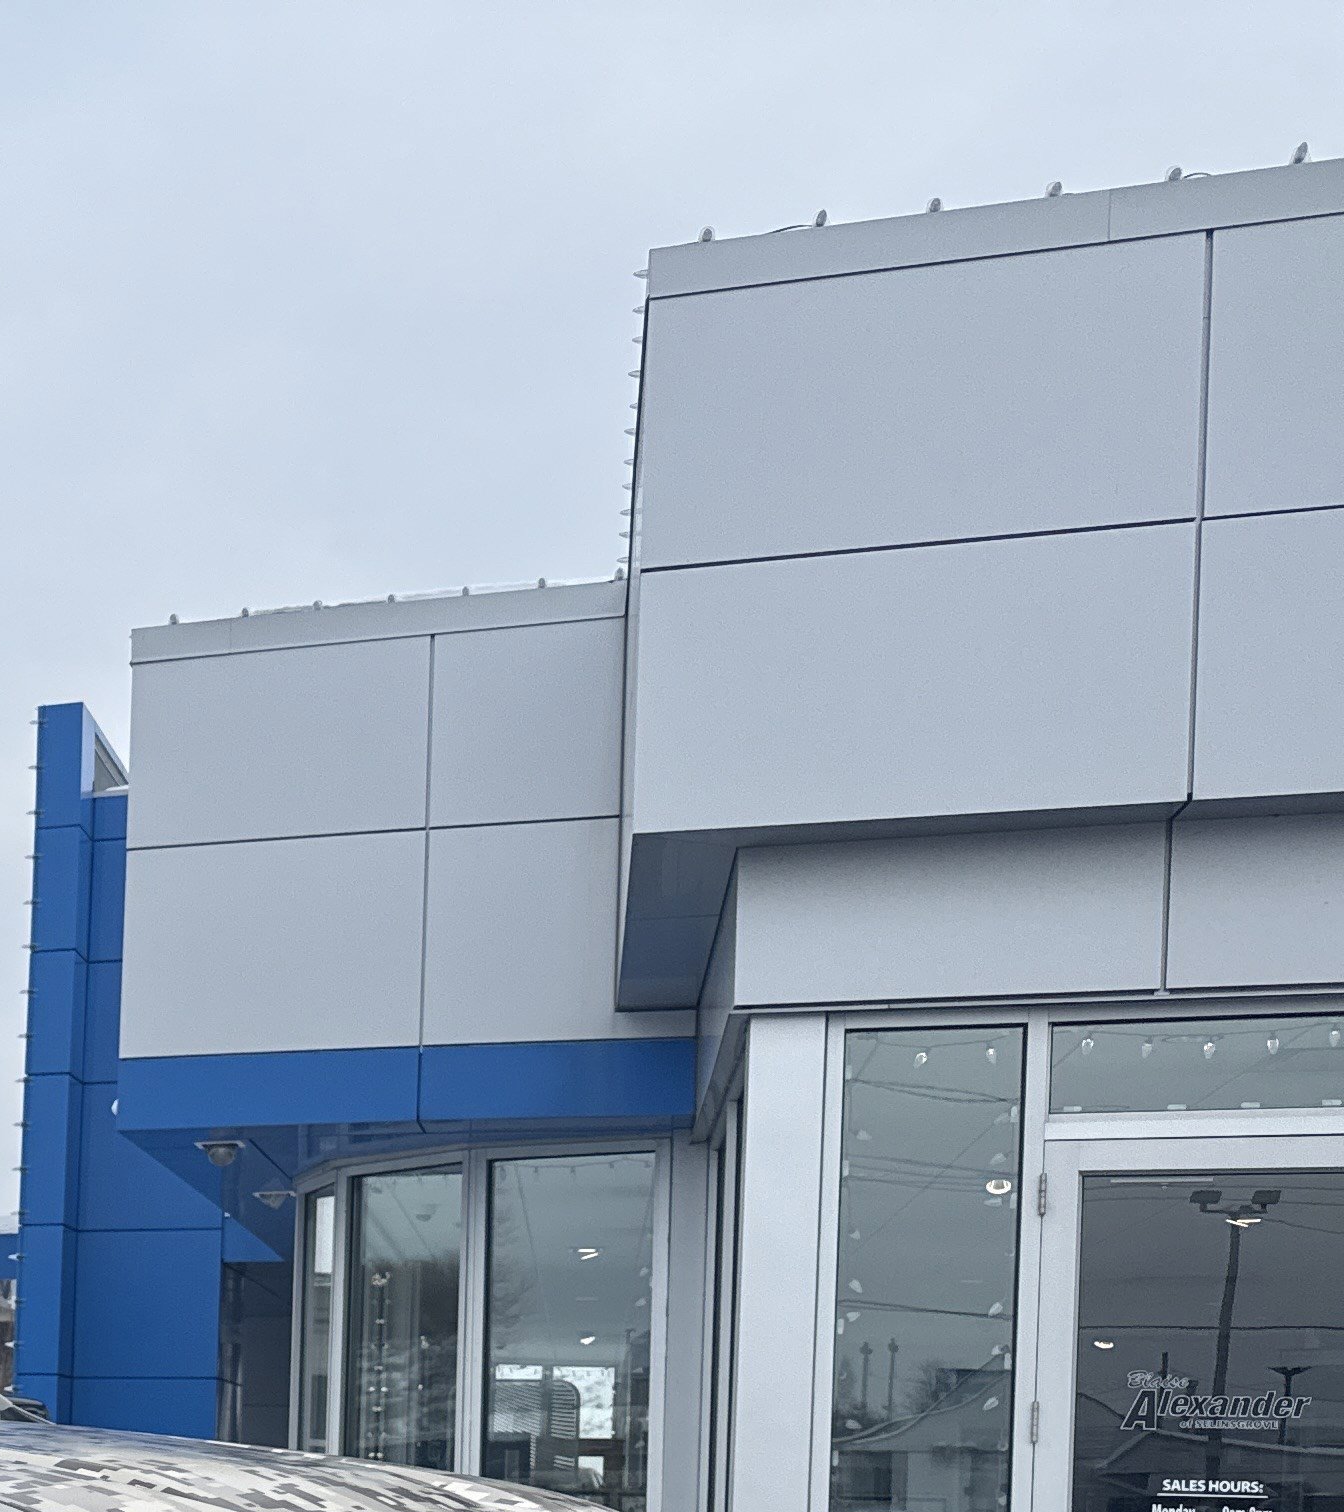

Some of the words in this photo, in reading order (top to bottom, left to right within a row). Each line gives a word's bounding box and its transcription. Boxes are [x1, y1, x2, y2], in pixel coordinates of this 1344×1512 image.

[1126, 1369, 1190, 1390] Blaise
[1120, 1388, 1313, 1431] Alexander
[1161, 1479, 1206, 1492] SALES
[1208, 1480, 1264, 1493] HOURS:
